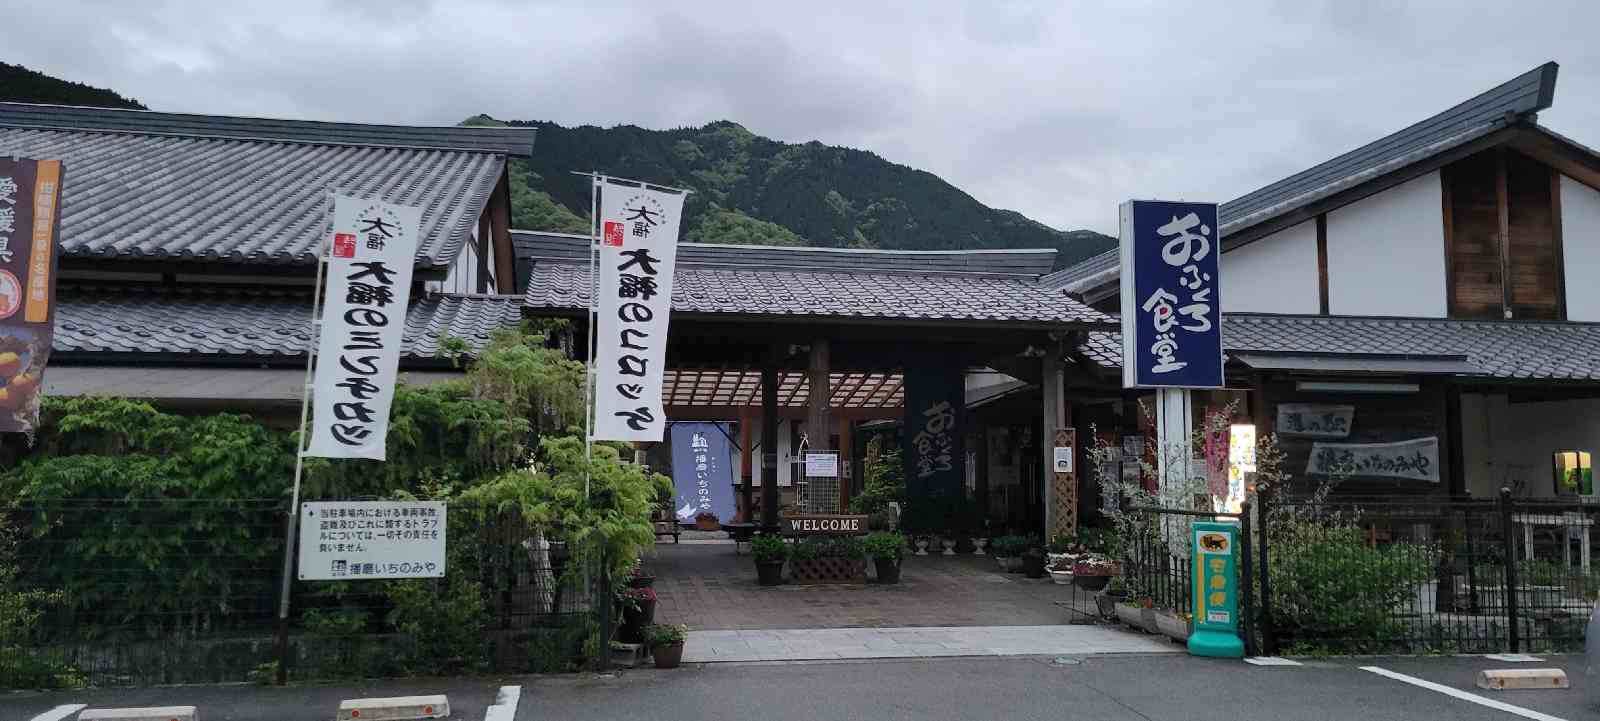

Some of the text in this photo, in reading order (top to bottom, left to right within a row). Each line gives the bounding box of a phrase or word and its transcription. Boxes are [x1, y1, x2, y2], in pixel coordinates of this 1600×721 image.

[1157, 212, 1212, 333] おふくろ
[1142, 287, 1188, 374] 食堂
[921, 400, 955, 472] おふくろ
[791, 519, 860, 531] WELCOME
[349, 562, 436, 576] 播磨いちのみや
